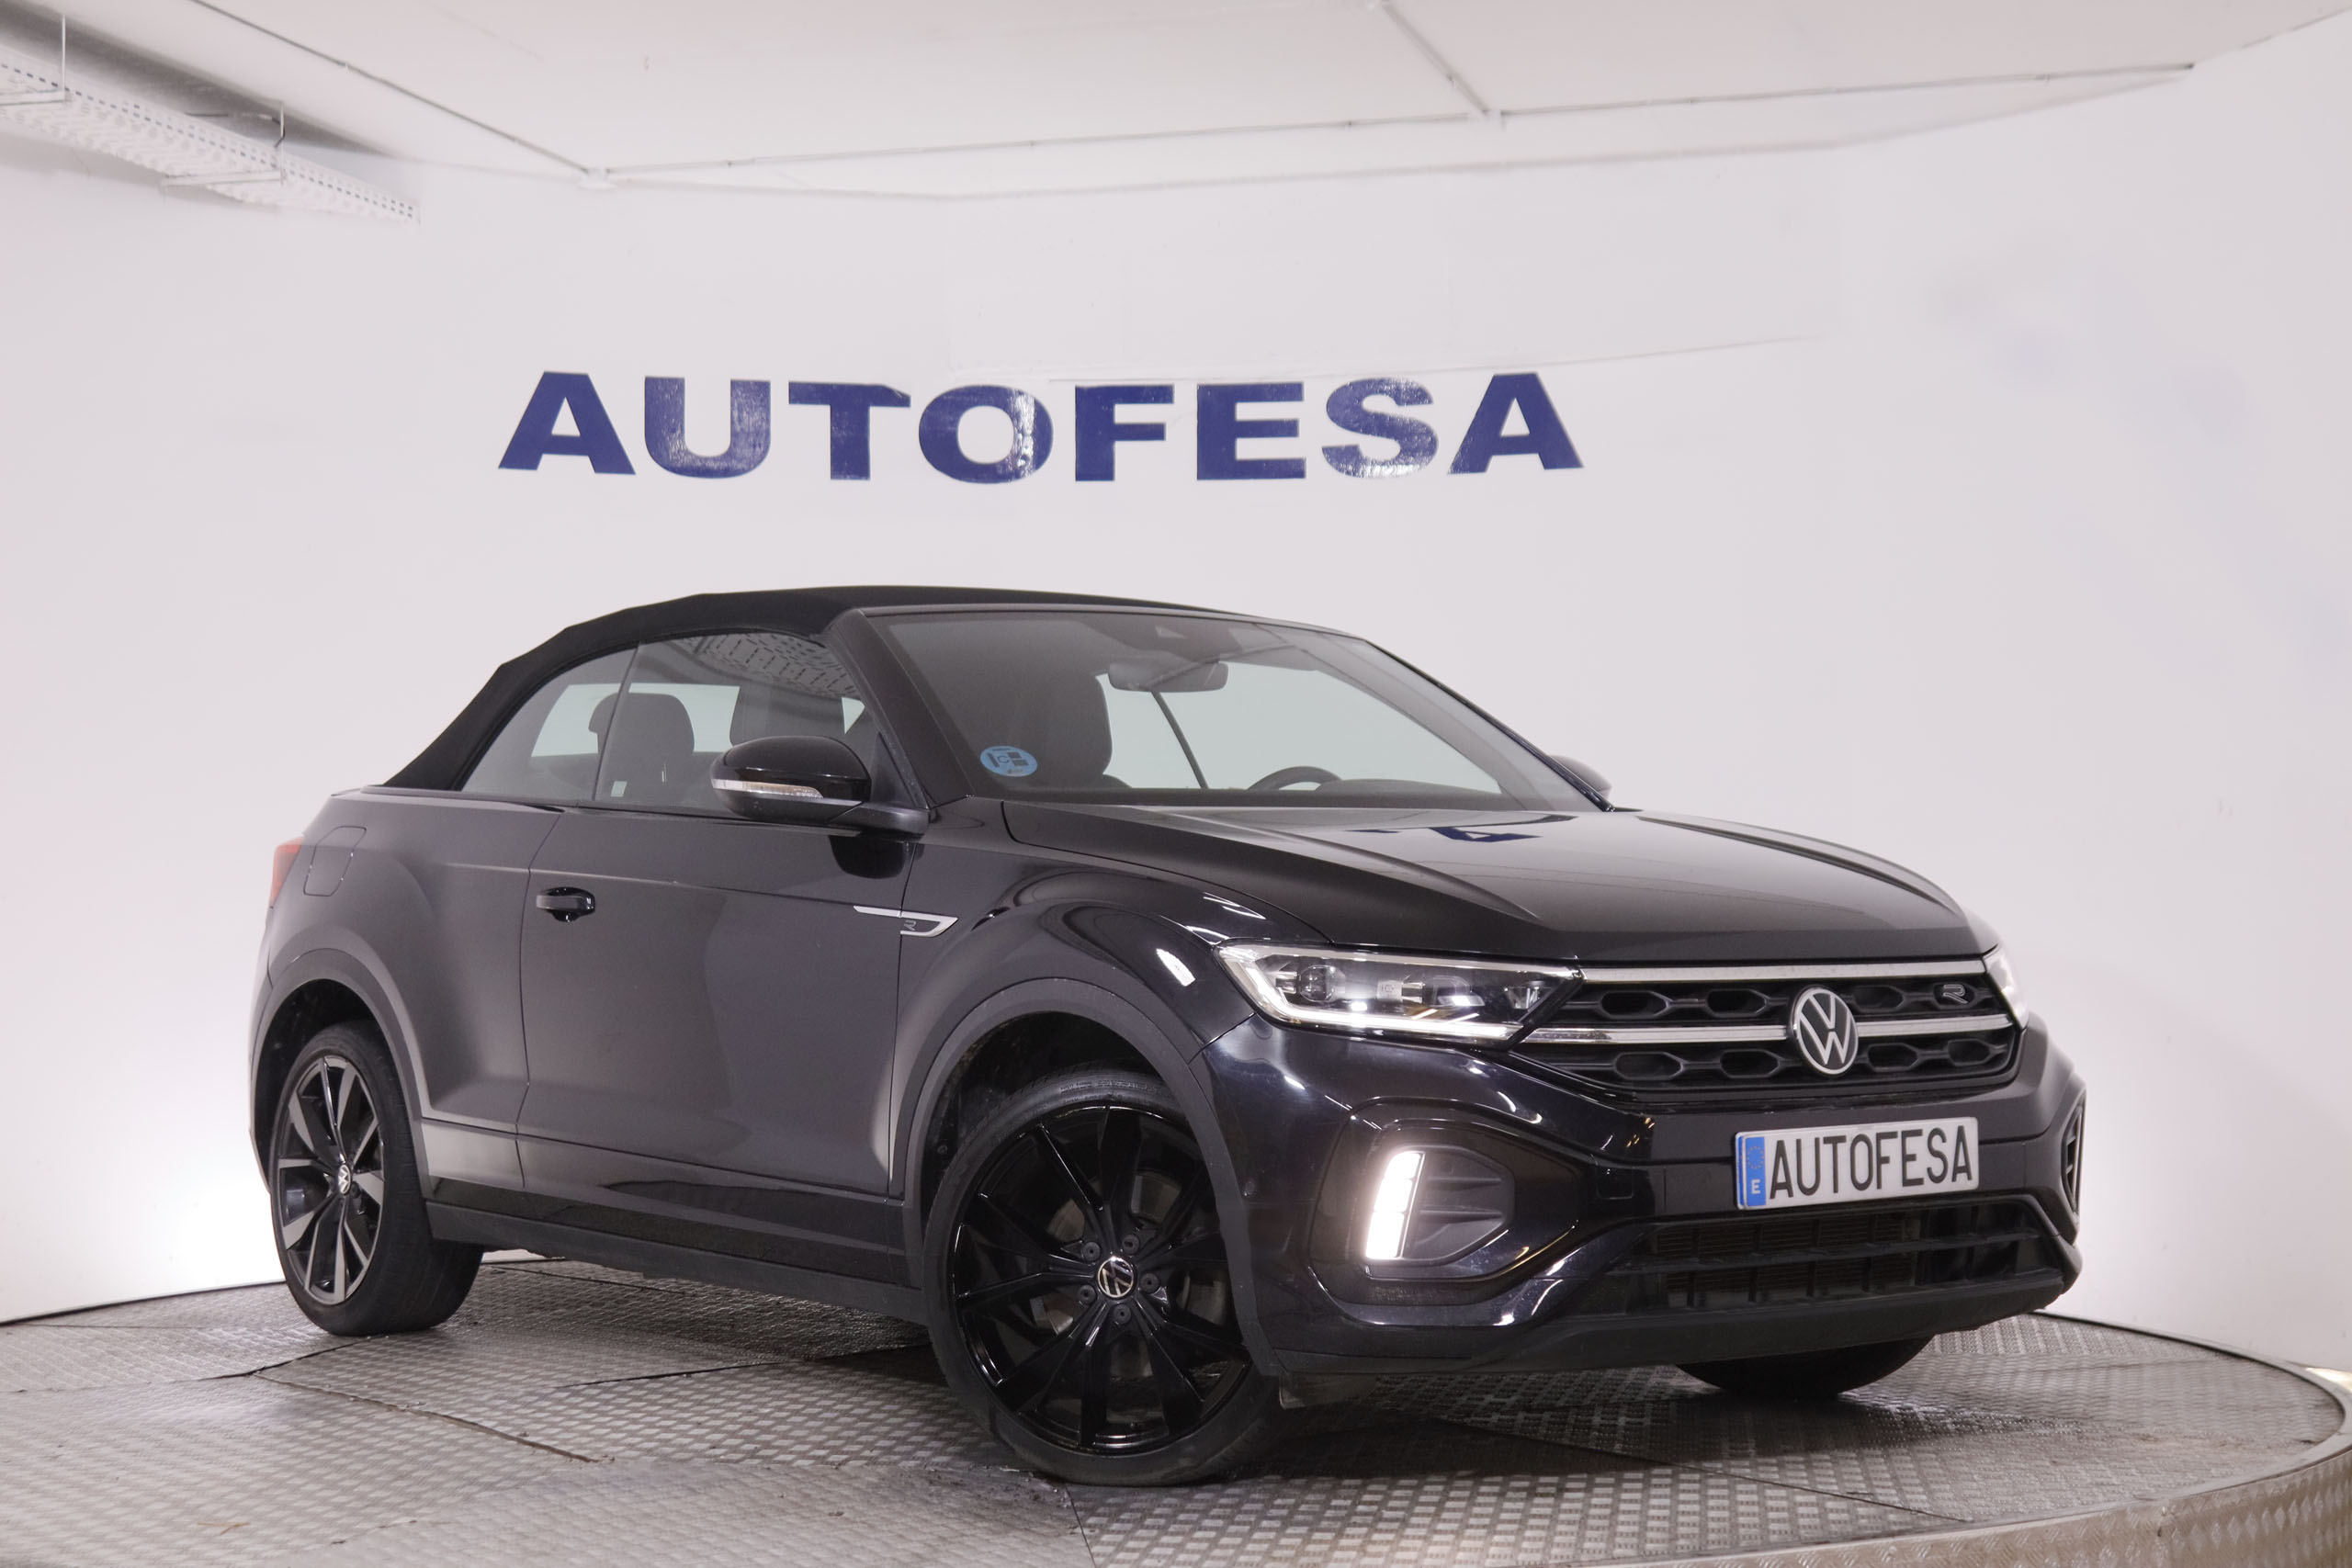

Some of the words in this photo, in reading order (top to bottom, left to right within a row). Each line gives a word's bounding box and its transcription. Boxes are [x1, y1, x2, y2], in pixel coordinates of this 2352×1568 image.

[498, 370, 1585, 483] AUTOFESA
[1794, 987, 1859, 1074] VW
[1943, 984, 1968, 1004] R
[1751, 1179, 1761, 1194] E
[1770, 1125, 1973, 1200] AUTOFESA
